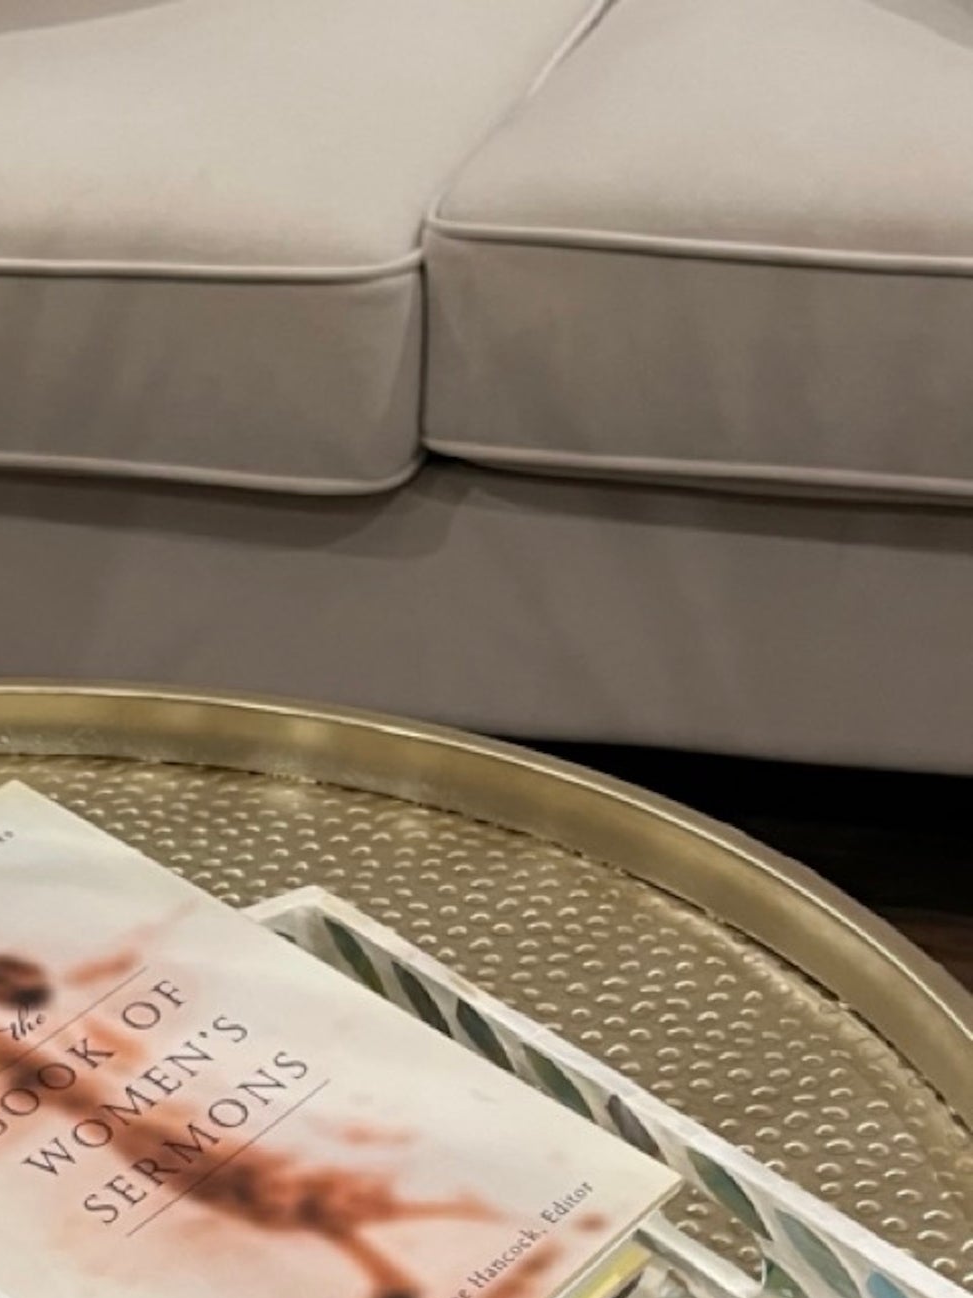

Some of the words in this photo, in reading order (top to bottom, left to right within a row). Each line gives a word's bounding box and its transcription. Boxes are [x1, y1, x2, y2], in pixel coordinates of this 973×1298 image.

[121, 979, 188, 1031] OF
[21, 1015, 248, 1177] WOMEN'S
[83, 1050, 309, 1224] SERMONS
[467, 1228, 548, 1288] Hancock,
[541, 1181, 595, 1225] Editor
